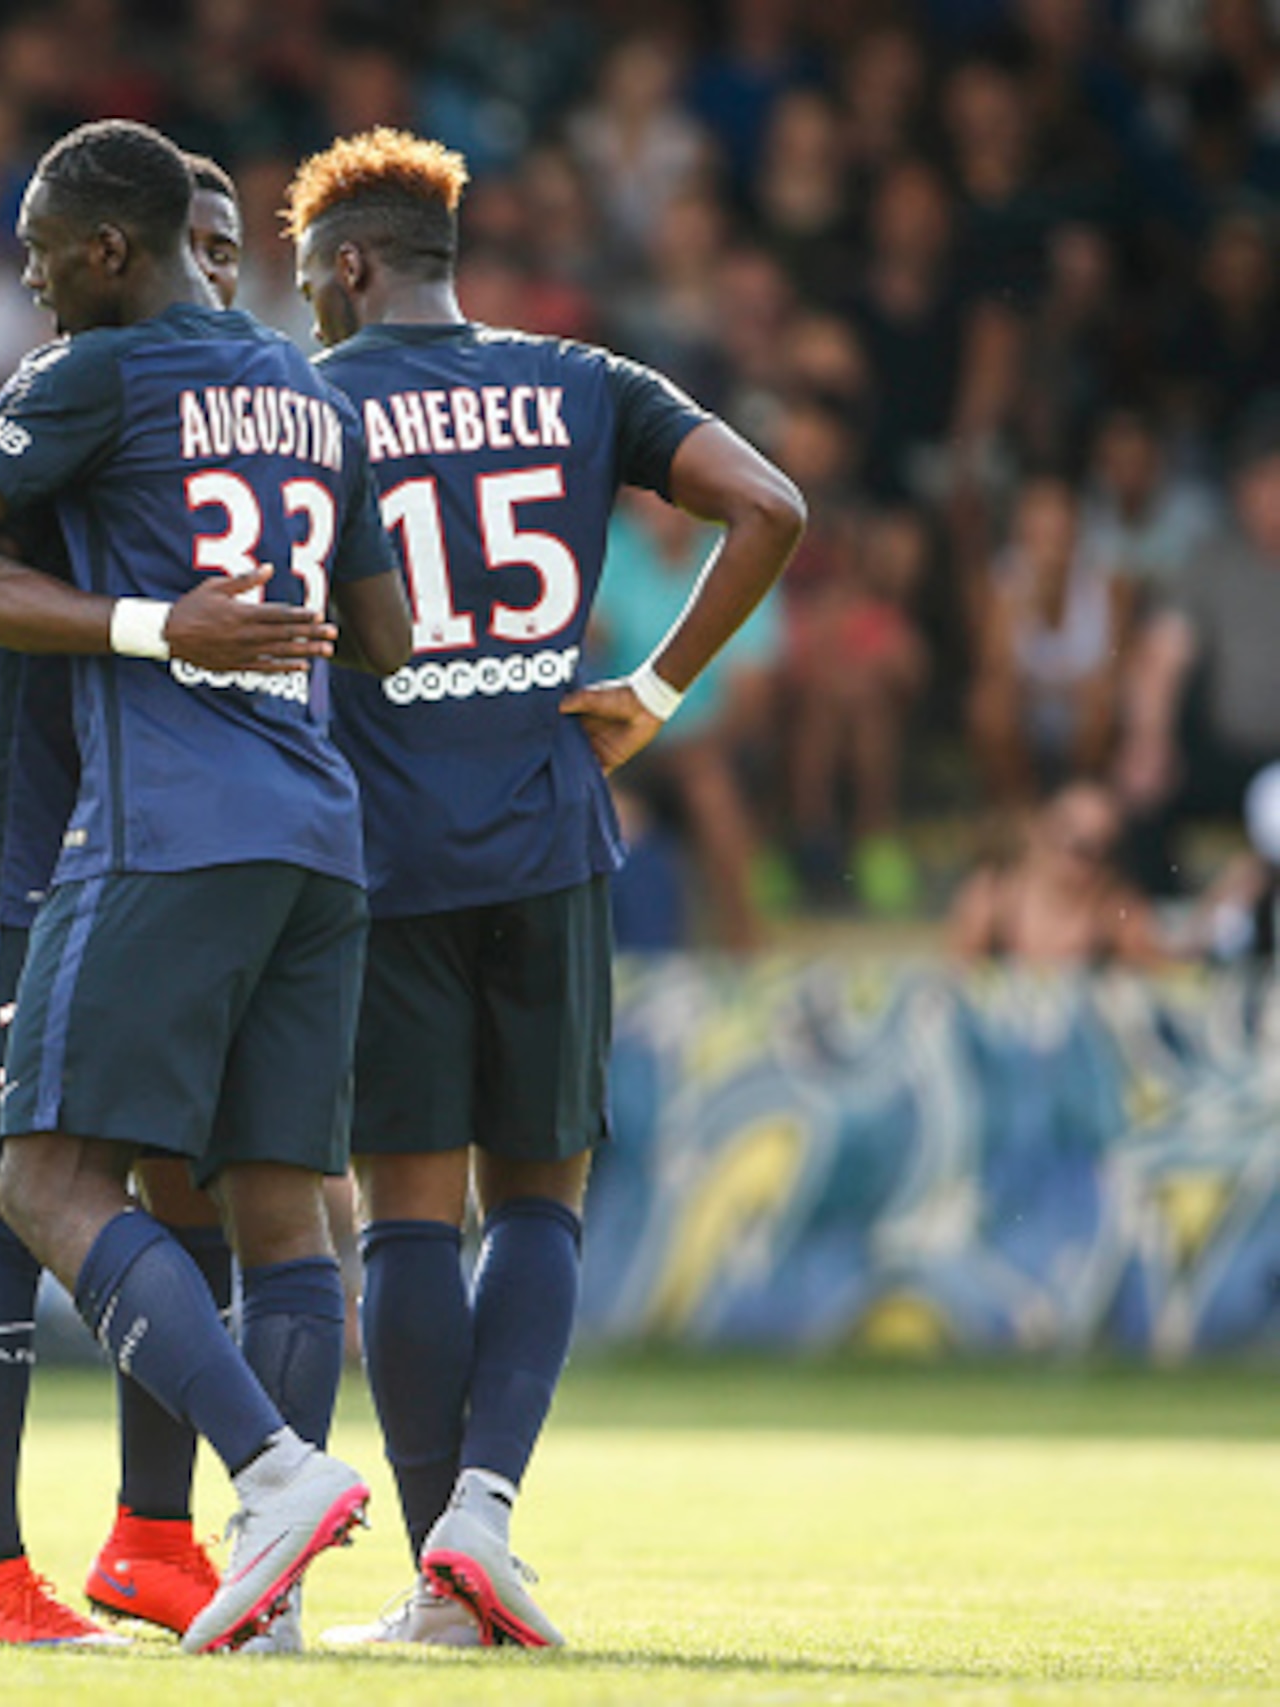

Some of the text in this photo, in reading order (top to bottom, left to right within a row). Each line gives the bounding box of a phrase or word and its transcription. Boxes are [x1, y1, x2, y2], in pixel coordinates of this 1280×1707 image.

[180, 385, 342, 473] AUGUSTIN
[363, 385, 571, 462] AHEBECK
[183, 467, 337, 618] 33
[378, 464, 582, 653] 15
